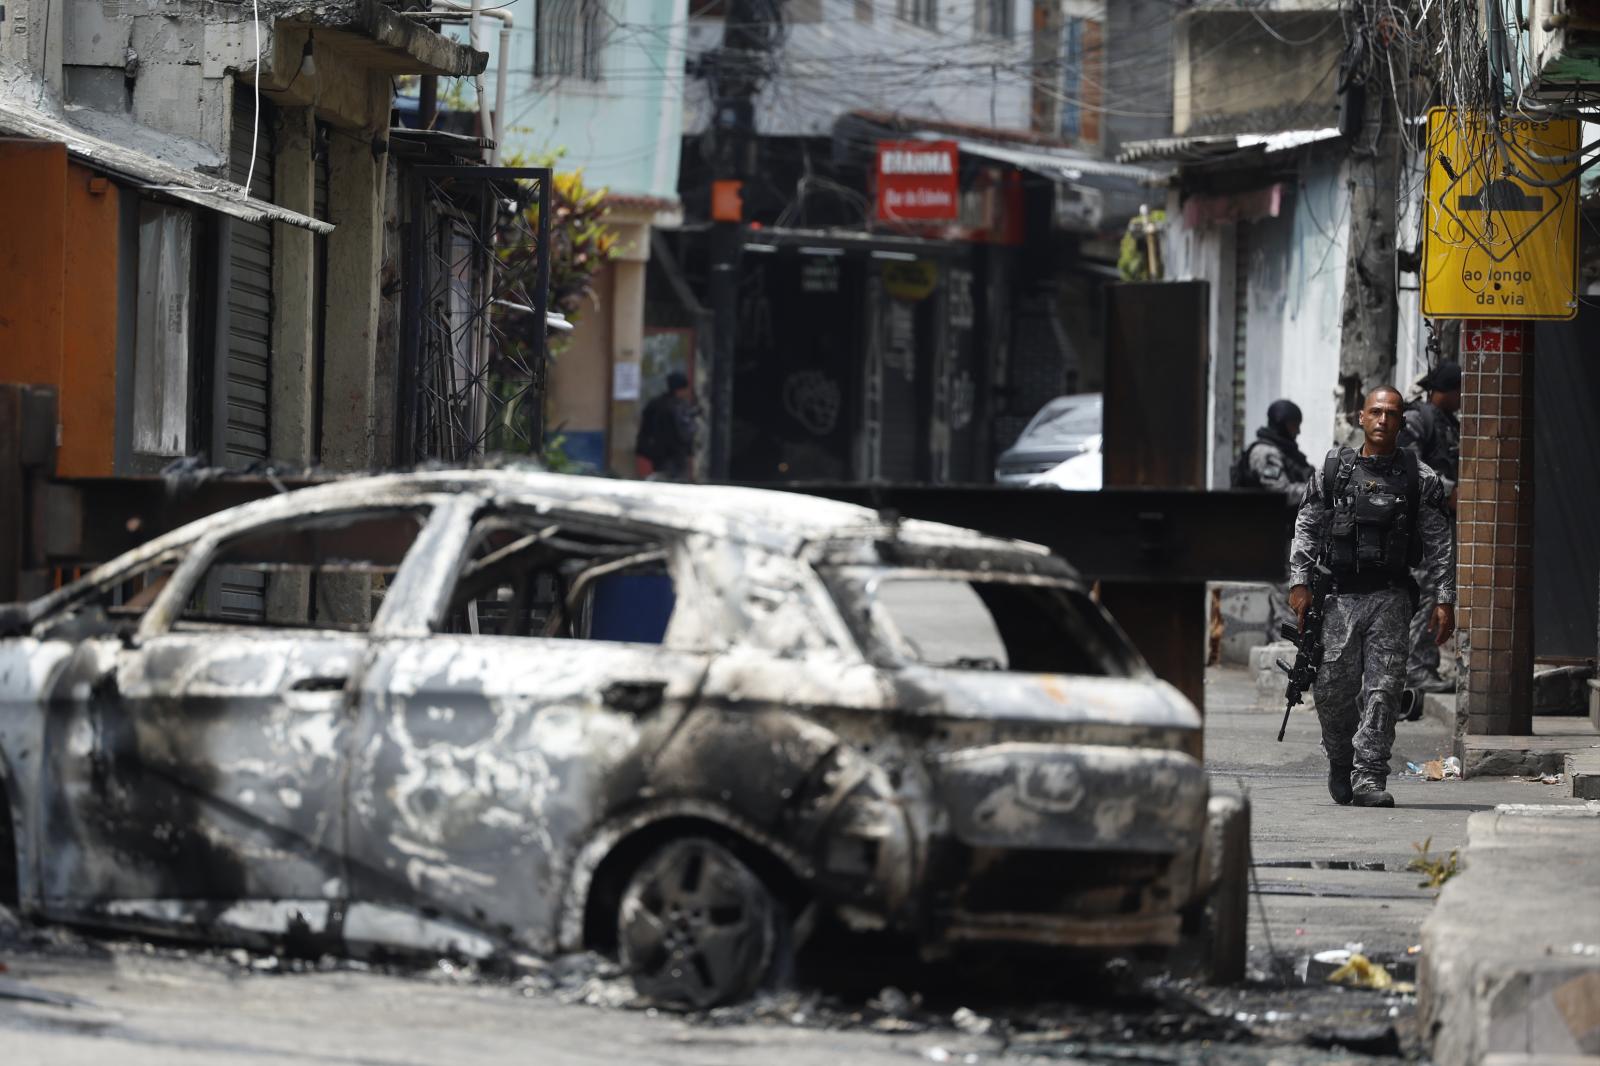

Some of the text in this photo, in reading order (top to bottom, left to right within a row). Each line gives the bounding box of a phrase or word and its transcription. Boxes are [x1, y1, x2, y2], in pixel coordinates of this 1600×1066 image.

[1464, 267, 1532, 285] ao longo
[1476, 291, 1524, 305] da via
